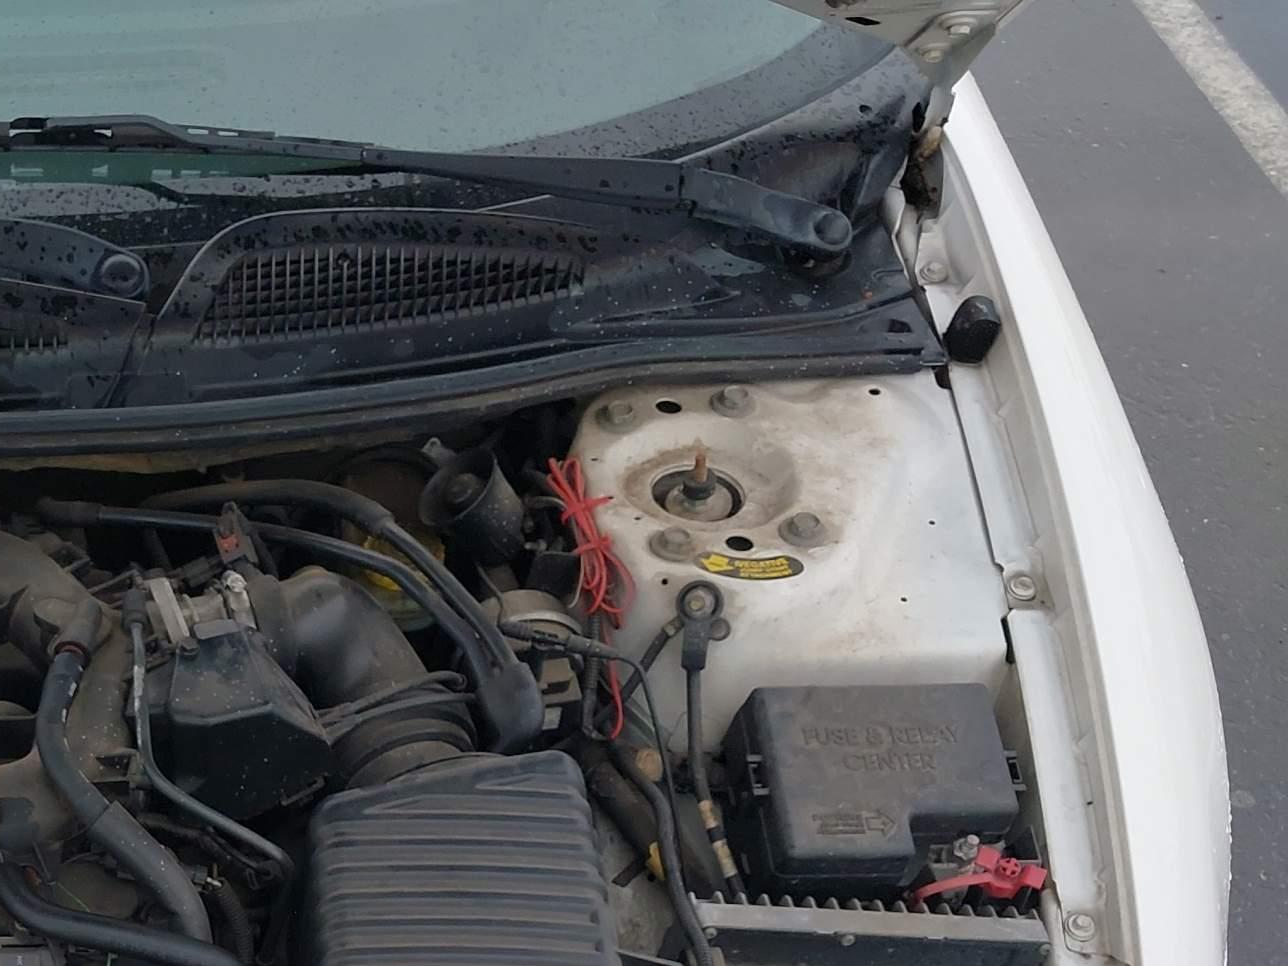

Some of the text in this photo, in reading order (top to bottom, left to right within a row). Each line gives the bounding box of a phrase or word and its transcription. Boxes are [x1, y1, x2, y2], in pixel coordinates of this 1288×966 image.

[800, 725, 958, 746] FUSE & RELAY
[843, 751, 937, 772] CENTER
